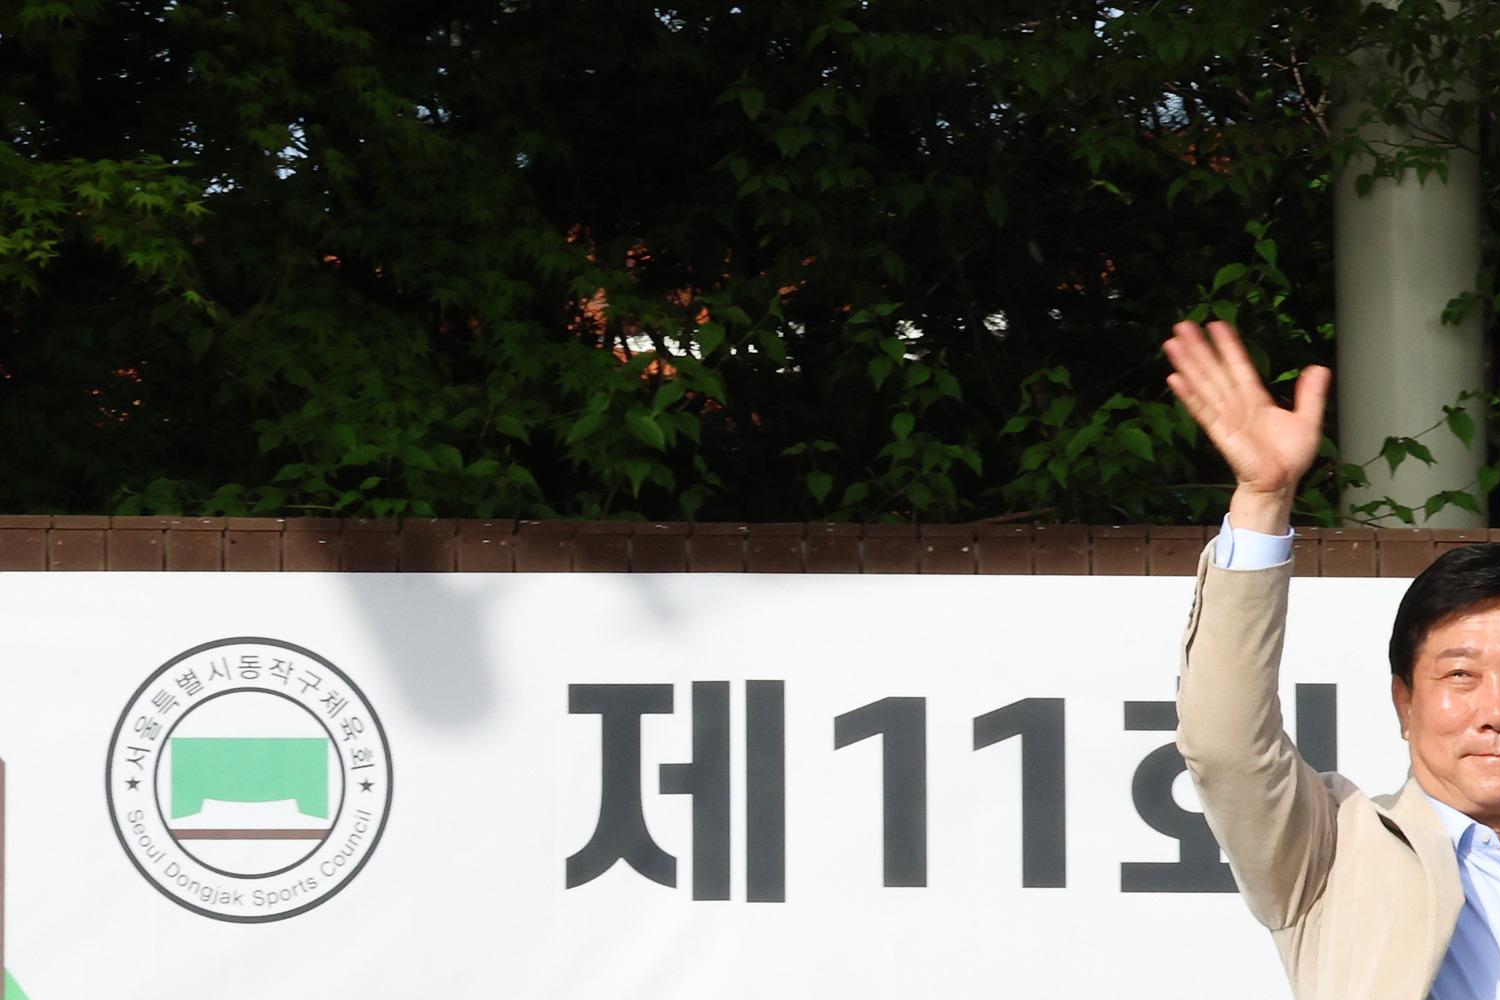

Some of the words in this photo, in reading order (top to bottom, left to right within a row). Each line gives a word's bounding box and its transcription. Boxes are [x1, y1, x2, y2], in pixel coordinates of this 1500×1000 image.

[127, 809, 167, 864] Seoul
[164, 862, 244, 907] Dongjak
[252, 875, 318, 909] Sports
[319, 808, 373, 878] Council
